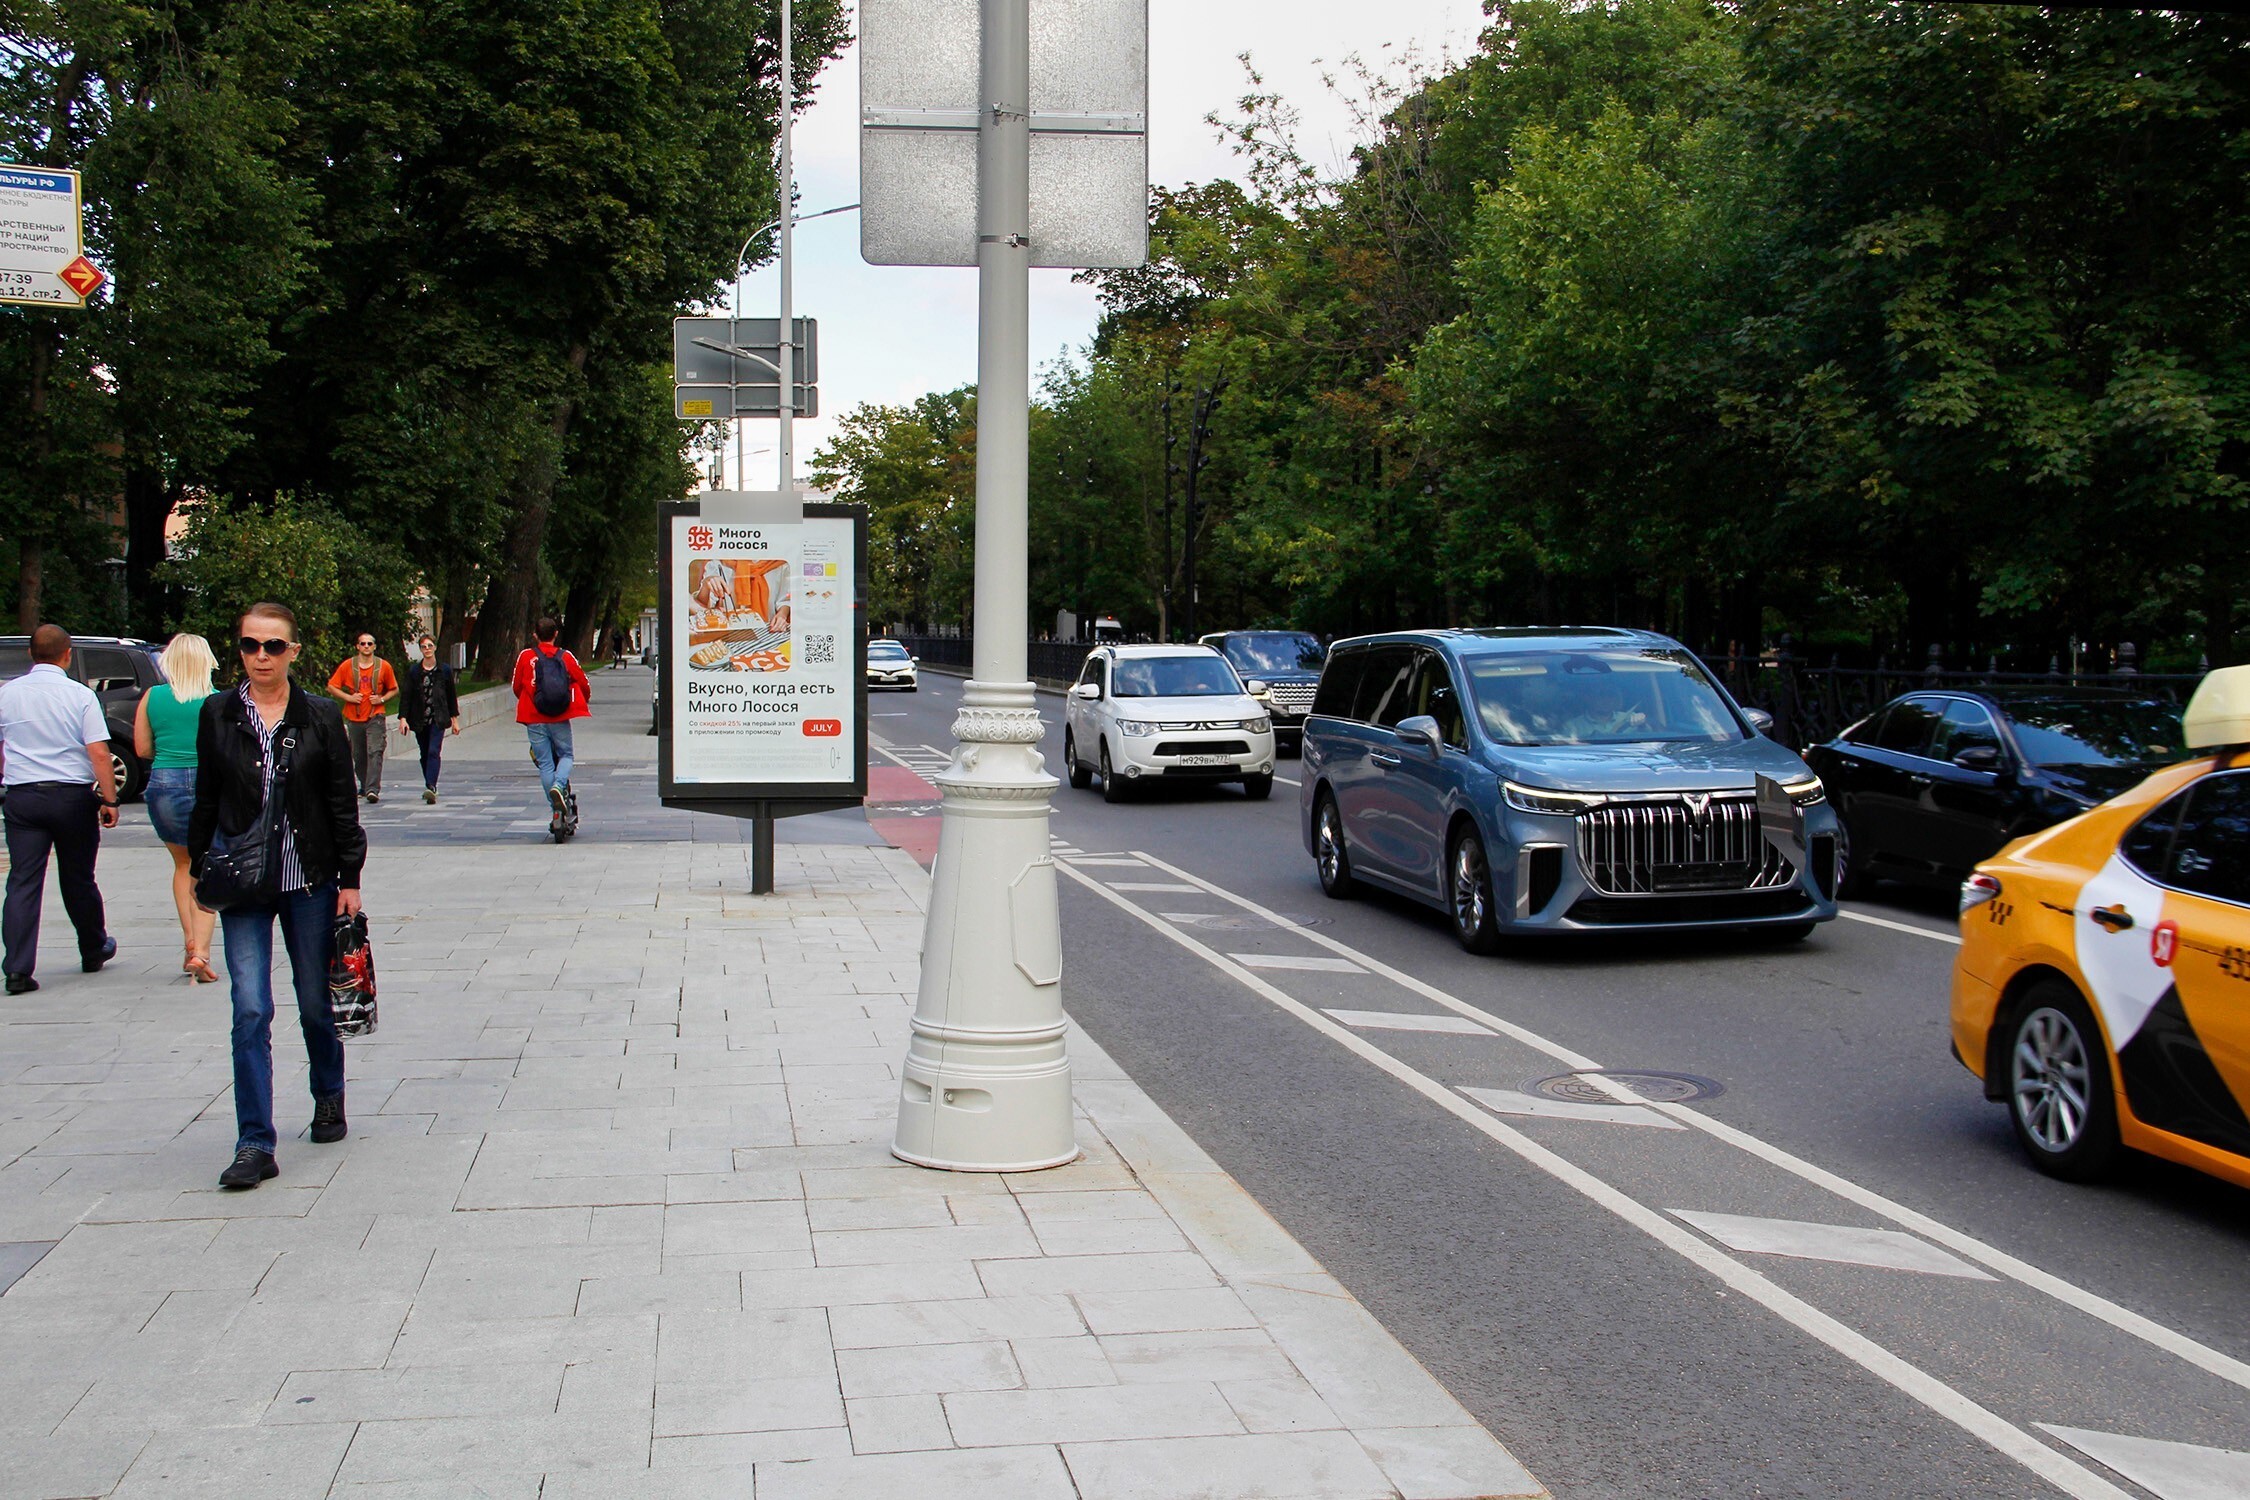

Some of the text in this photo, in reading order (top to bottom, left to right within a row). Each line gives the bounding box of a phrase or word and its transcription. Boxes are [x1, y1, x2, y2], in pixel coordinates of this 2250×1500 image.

[40, 178, 55, 188] РФ
[23, 192, 73, 203] БЮДЖЕТНОЕ
[14, 232, 50, 242] НАЦИЙ
[719, 528, 761, 539] Много
[719, 540, 768, 550] лосося
[689, 681, 835, 696] Вкусно, когда есть
[689, 701, 799, 712] Много Лосося
[699, 720, 727, 728] скидкой
[752, 720, 776, 728] первый
[811, 724, 833, 732] JULY
